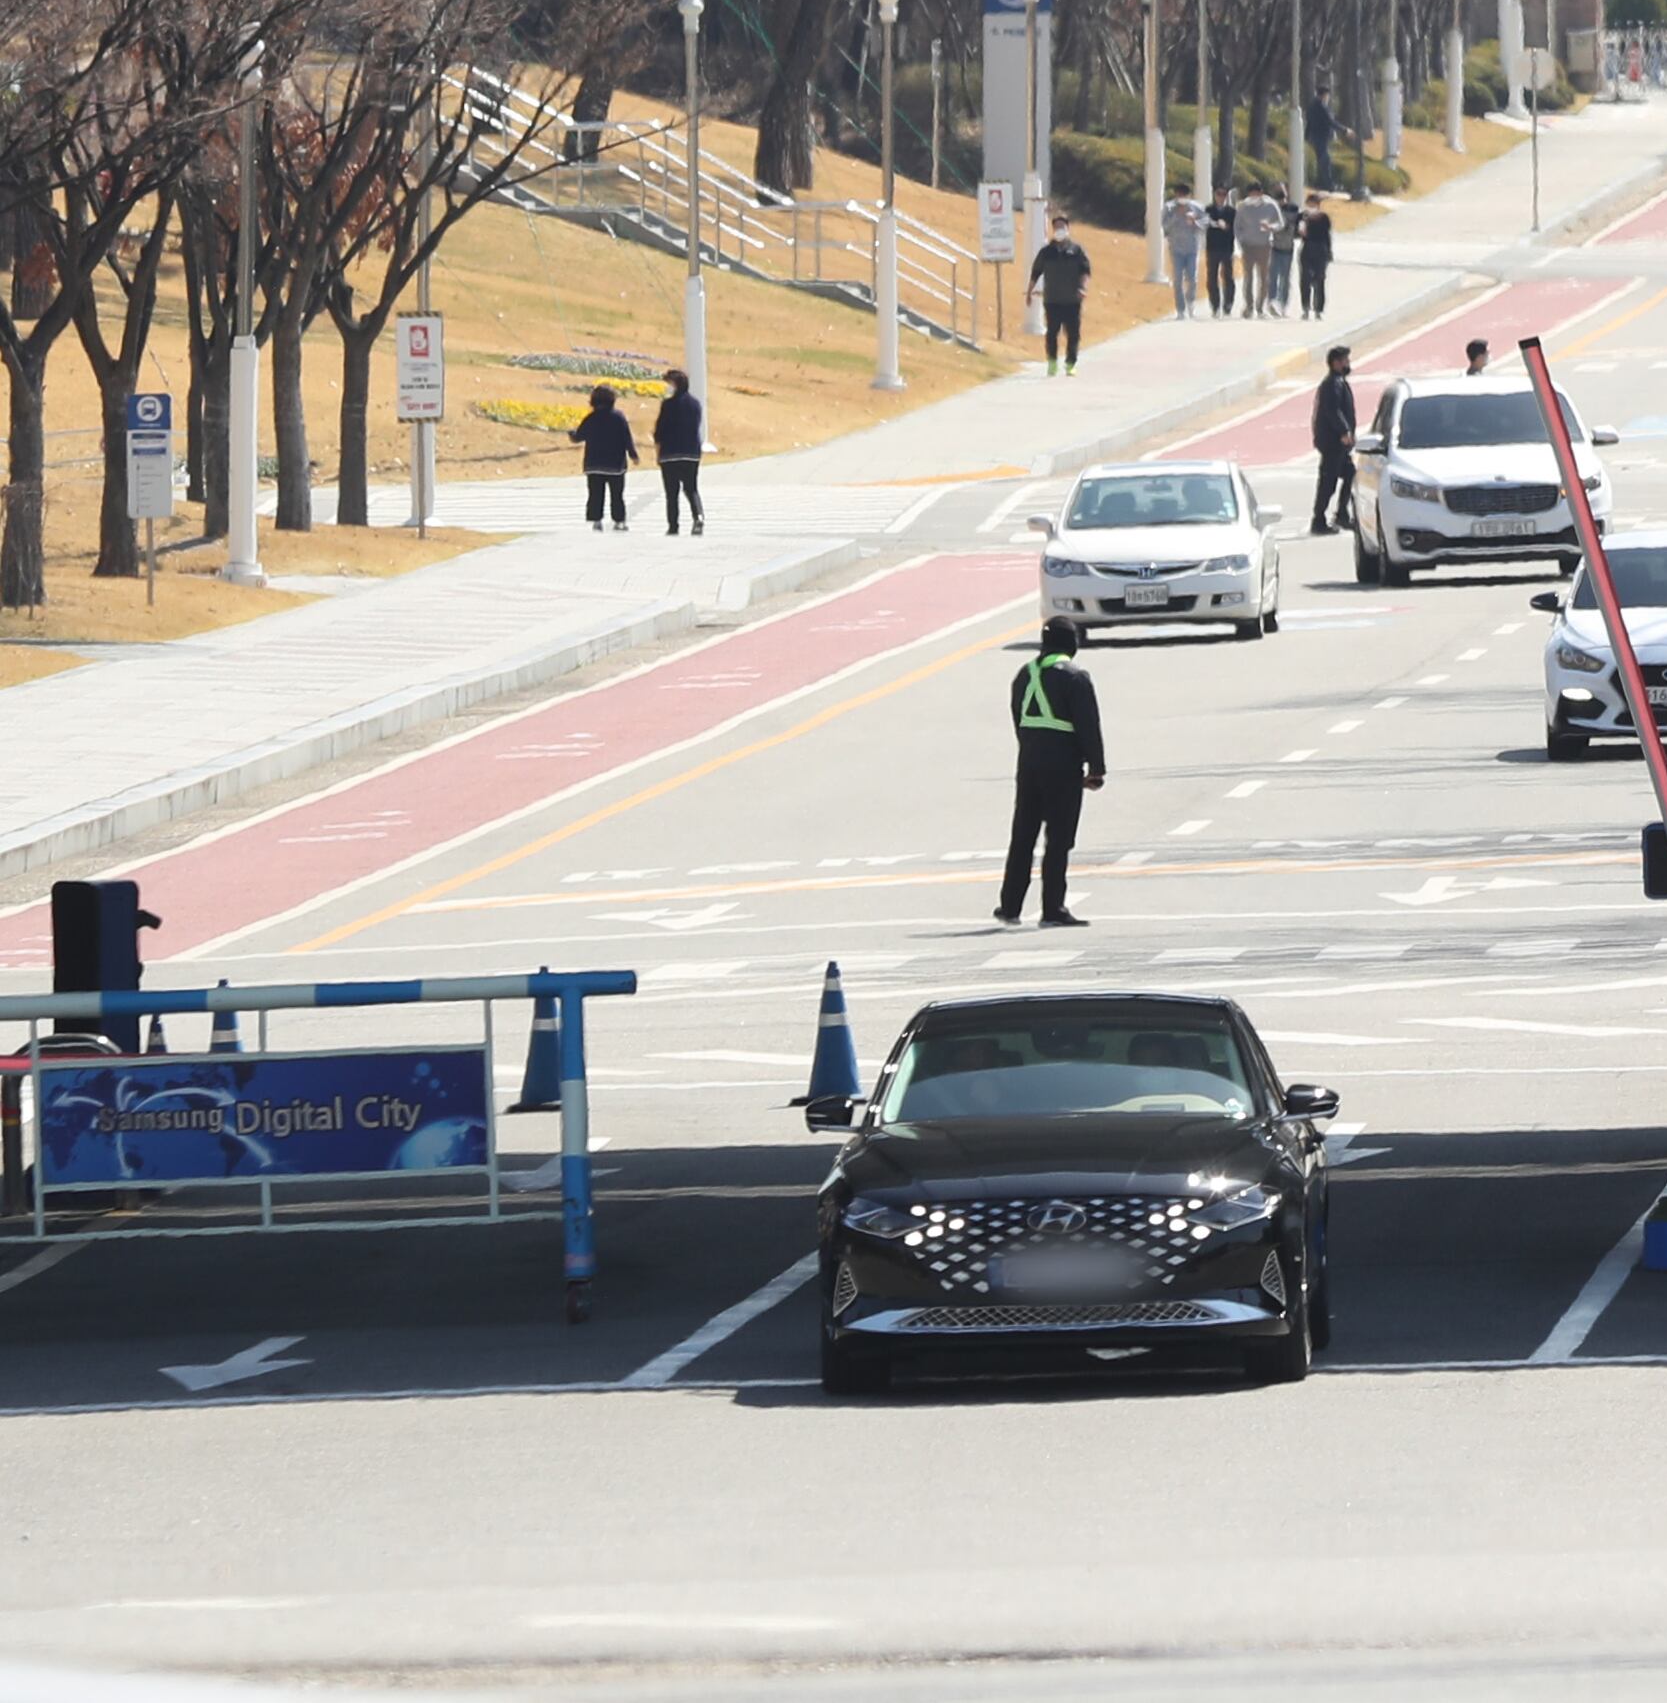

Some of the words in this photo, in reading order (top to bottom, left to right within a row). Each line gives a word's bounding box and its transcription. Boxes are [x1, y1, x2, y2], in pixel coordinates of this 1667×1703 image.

[100, 1107, 225, 1134] Samsung
[234, 1096, 343, 1137] Digital
[355, 1095, 423, 1133] City
